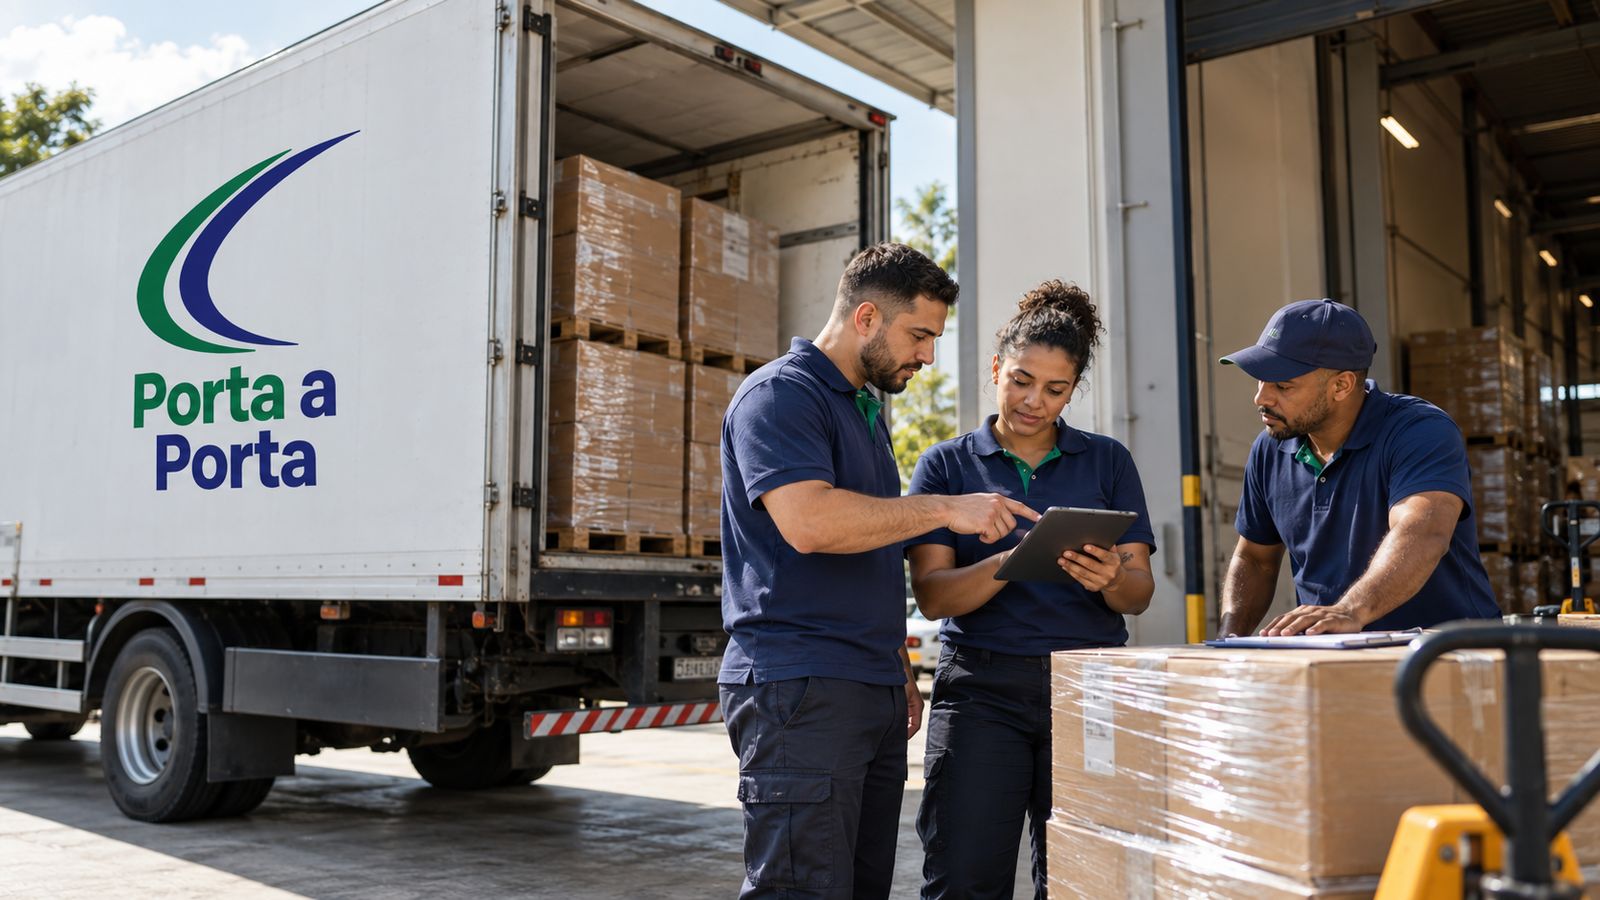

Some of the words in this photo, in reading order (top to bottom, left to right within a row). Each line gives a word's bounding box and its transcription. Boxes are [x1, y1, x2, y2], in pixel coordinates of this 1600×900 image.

[133, 366, 285, 428] Porta
[300, 370, 336, 418] a
[156, 430, 317, 491] Porta
